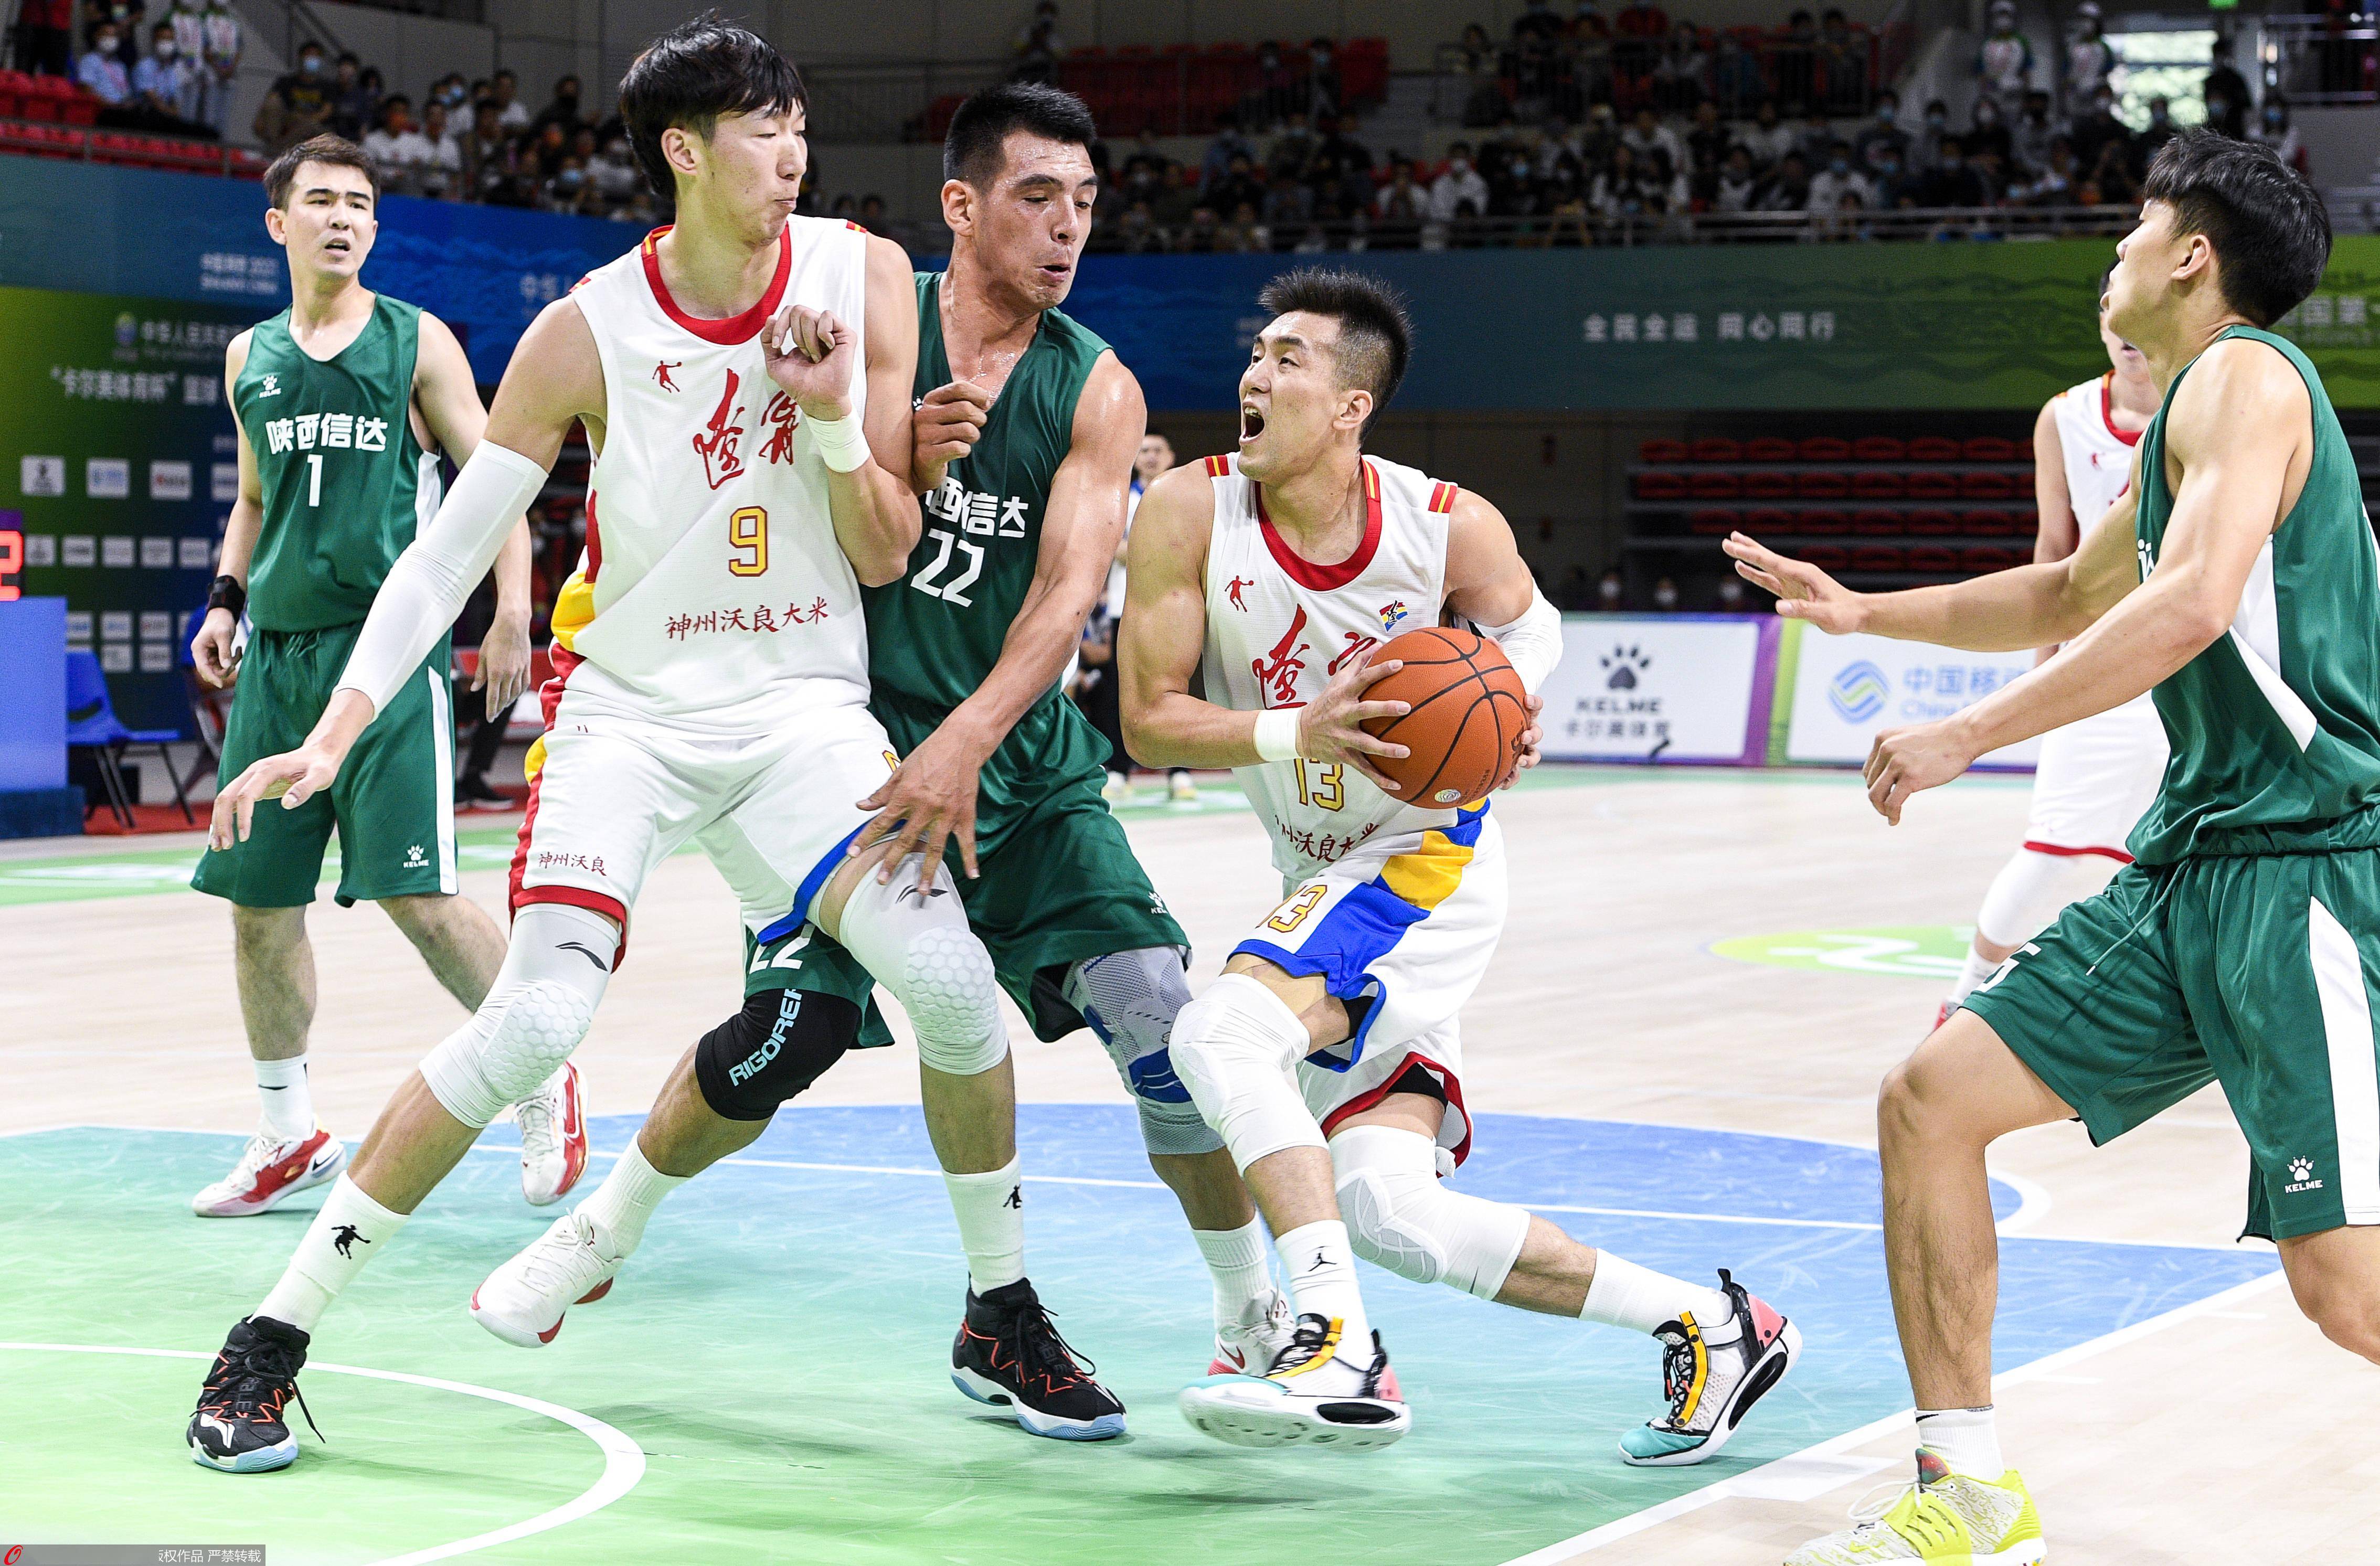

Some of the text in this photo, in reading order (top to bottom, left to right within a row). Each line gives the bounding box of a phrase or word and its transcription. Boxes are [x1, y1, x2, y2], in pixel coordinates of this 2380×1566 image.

[259, 388, 281, 398] KELME
[265, 413, 388, 454] 陕西信达
[307, 454, 323, 507] 1
[926, 476, 1029, 538] 西信达
[729, 505, 768, 577] 9
[910, 528, 984, 608] 22
[664, 596, 828, 641] 神州沃良大米
[1576, 697, 1662, 713] KELME
[1293, 758, 1344, 812] 13
[403, 859, 429, 868] KELME
[539, 851, 607, 876] 神州沃良
[2285, 1179, 2323, 1194] KELME
